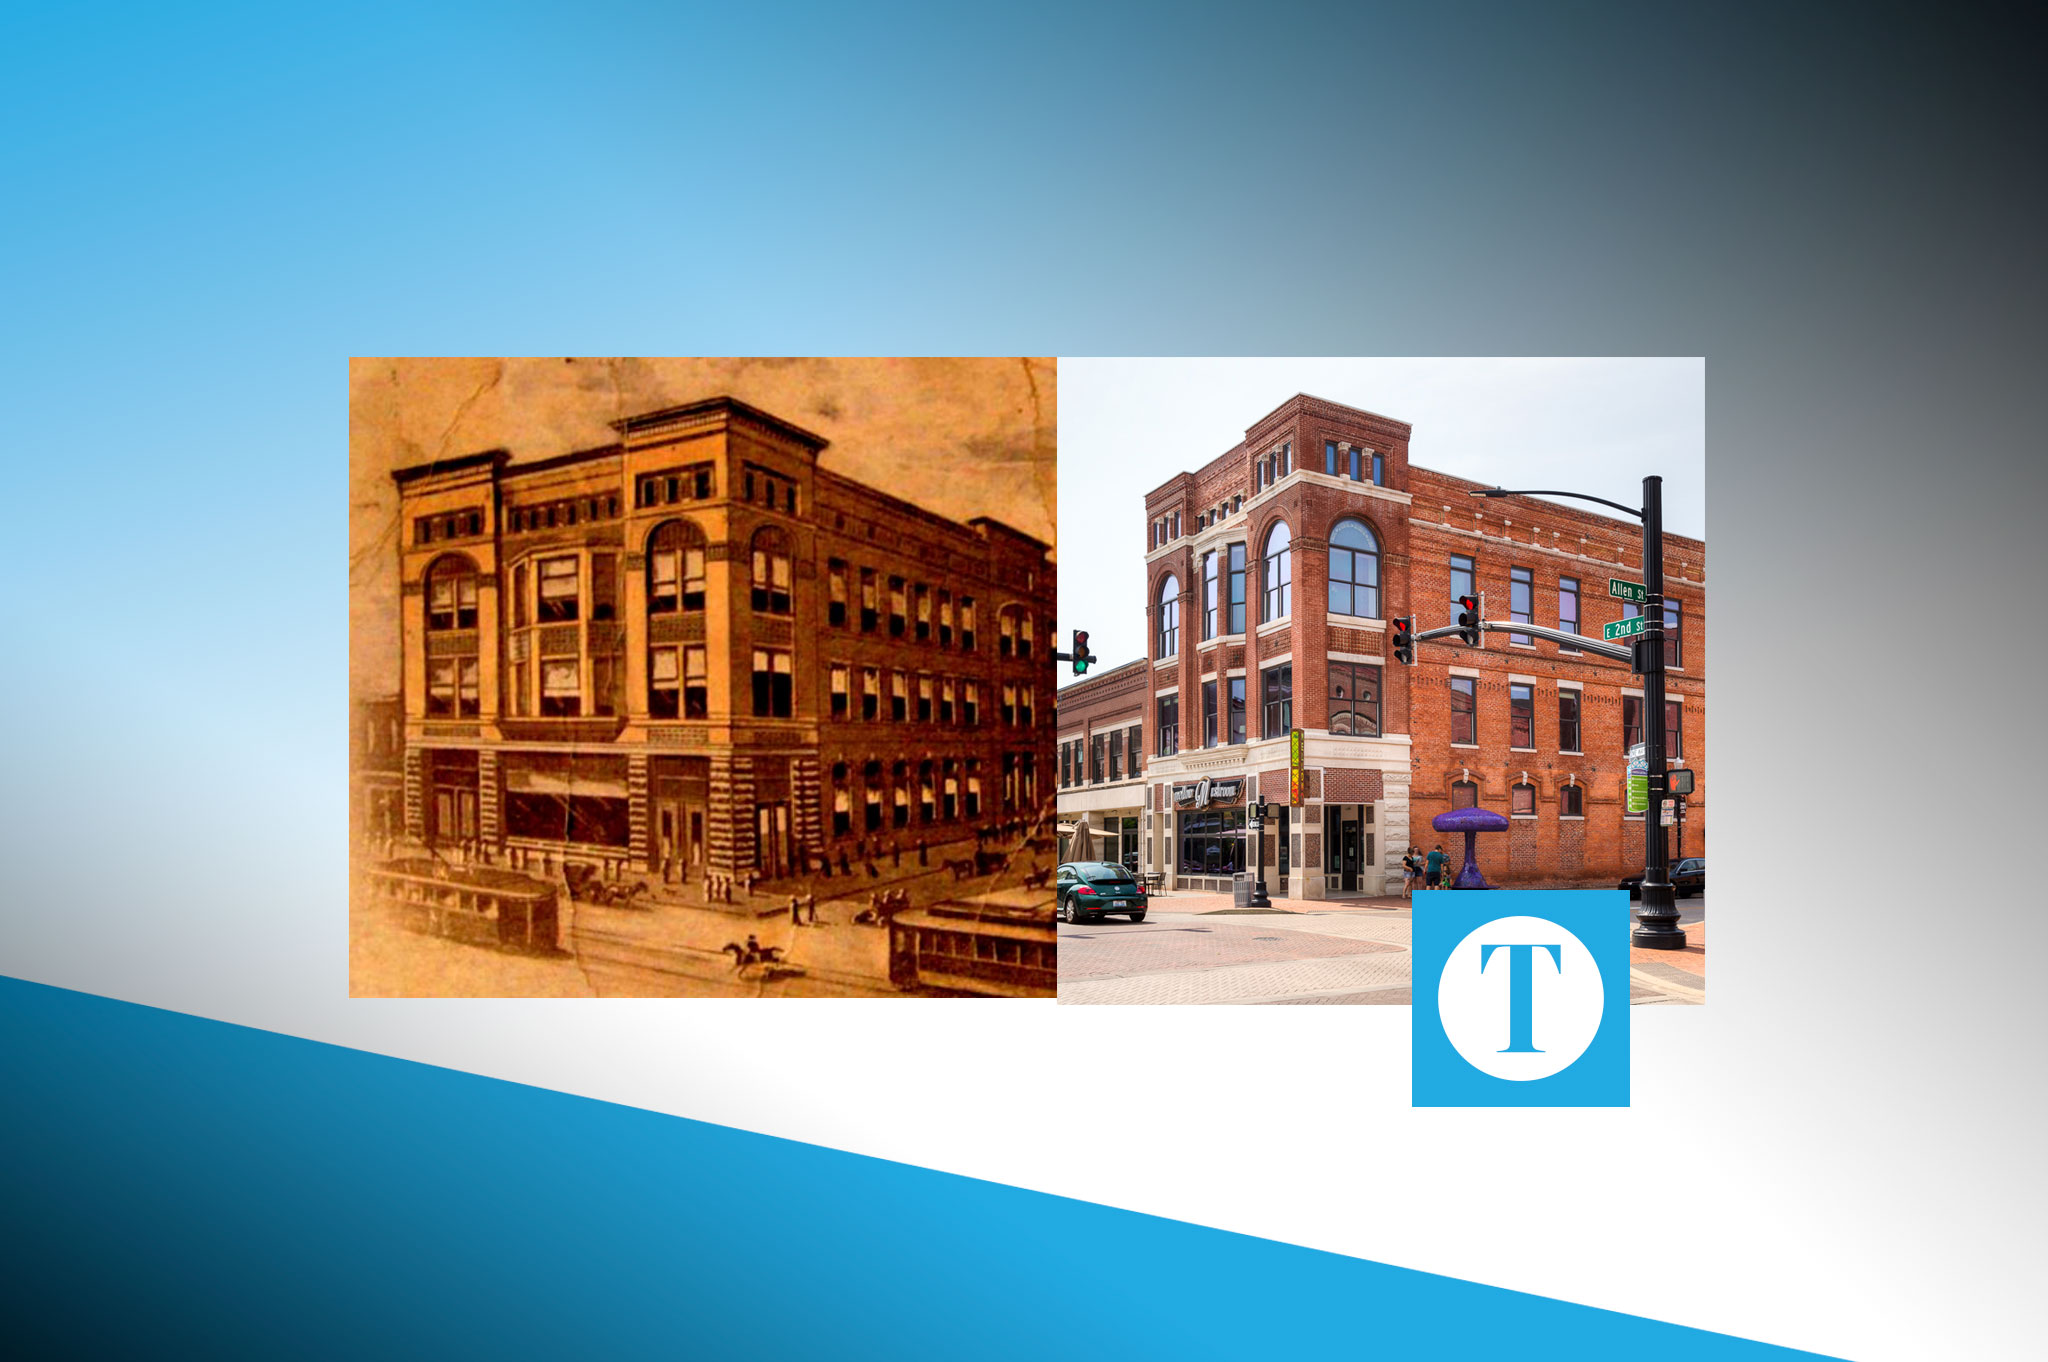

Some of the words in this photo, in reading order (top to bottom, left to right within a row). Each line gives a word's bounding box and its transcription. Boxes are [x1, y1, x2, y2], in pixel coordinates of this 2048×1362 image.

[1611, 581, 1632, 598] Allen
[1637, 589, 1644, 600] St
[1606, 628, 1610, 638] E
[1615, 621, 1631, 636] 2nd
[1636, 621, 1644, 631] St
